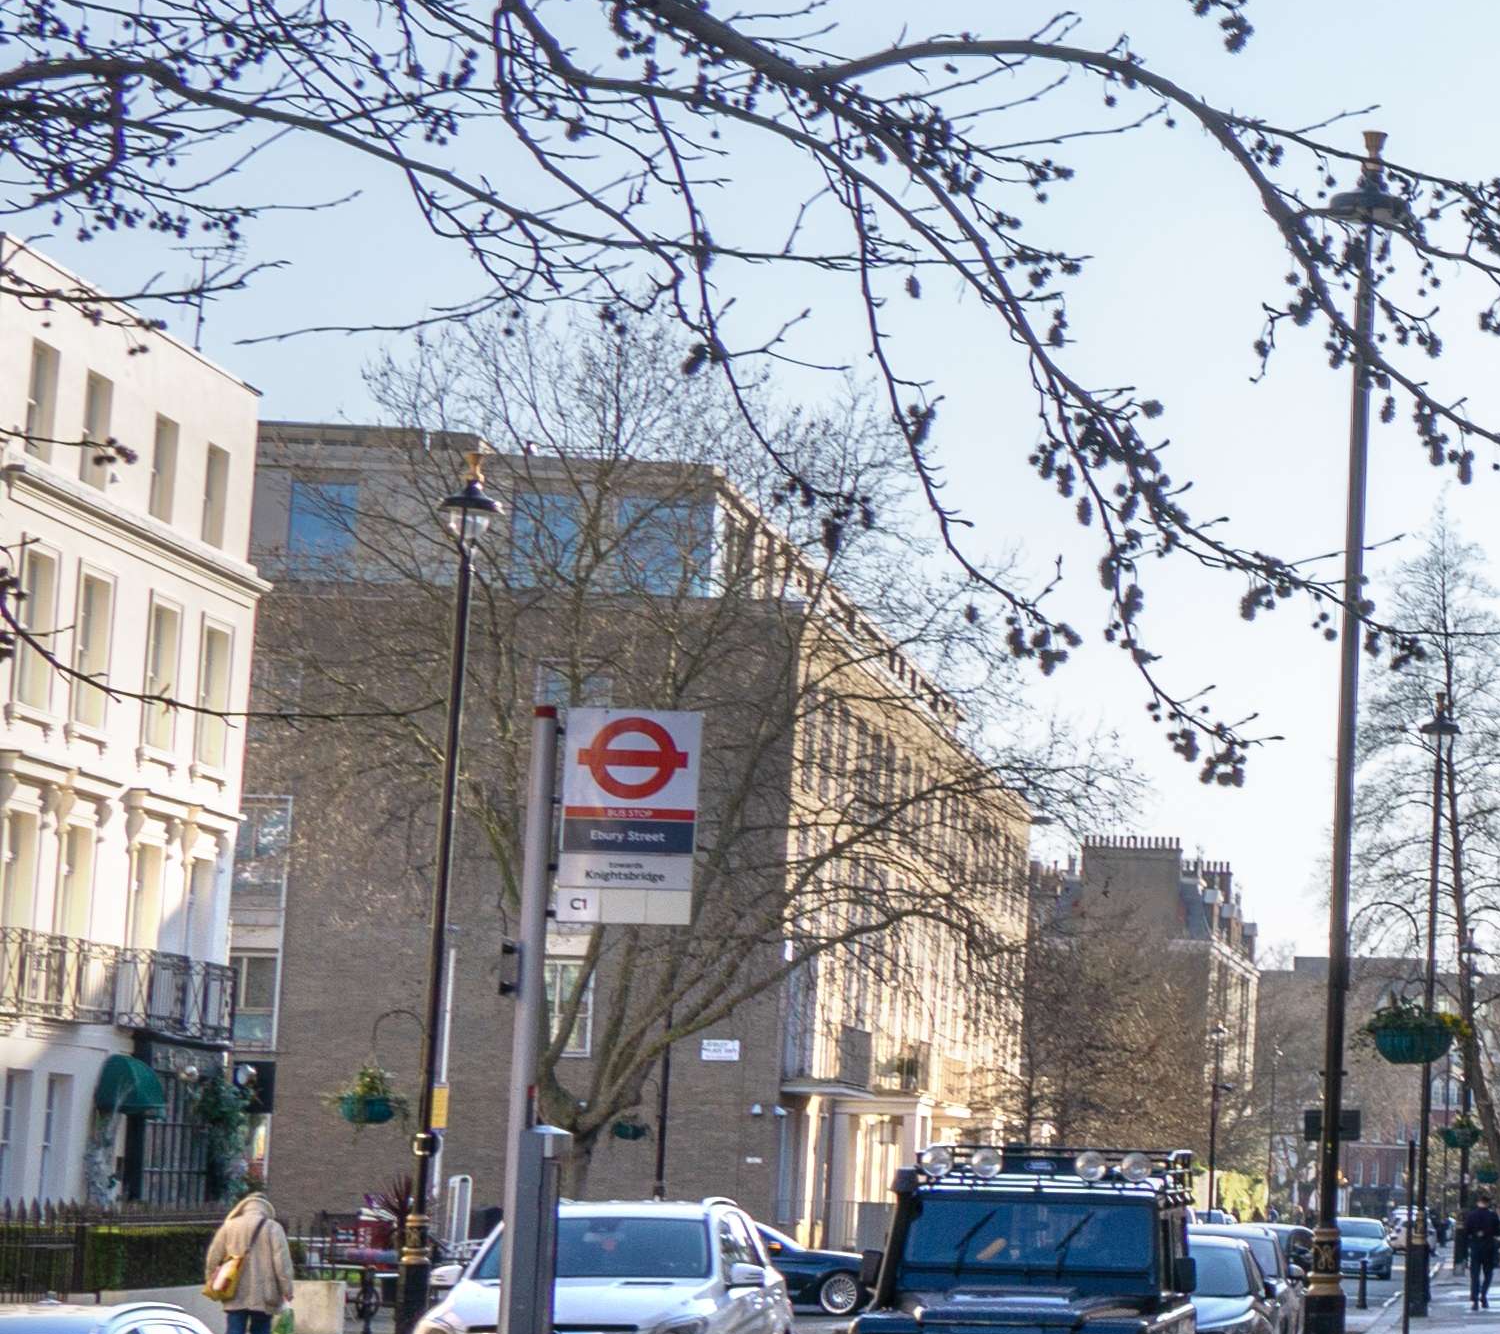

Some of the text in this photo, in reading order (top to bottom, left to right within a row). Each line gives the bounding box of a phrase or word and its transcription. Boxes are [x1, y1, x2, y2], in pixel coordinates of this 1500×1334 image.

[607, 809, 653, 818] BUS STOP
[590, 829, 666, 843] Ebury Street
[585, 869, 666, 883] Knightsbridge
[570, 897, 588, 910] C1
